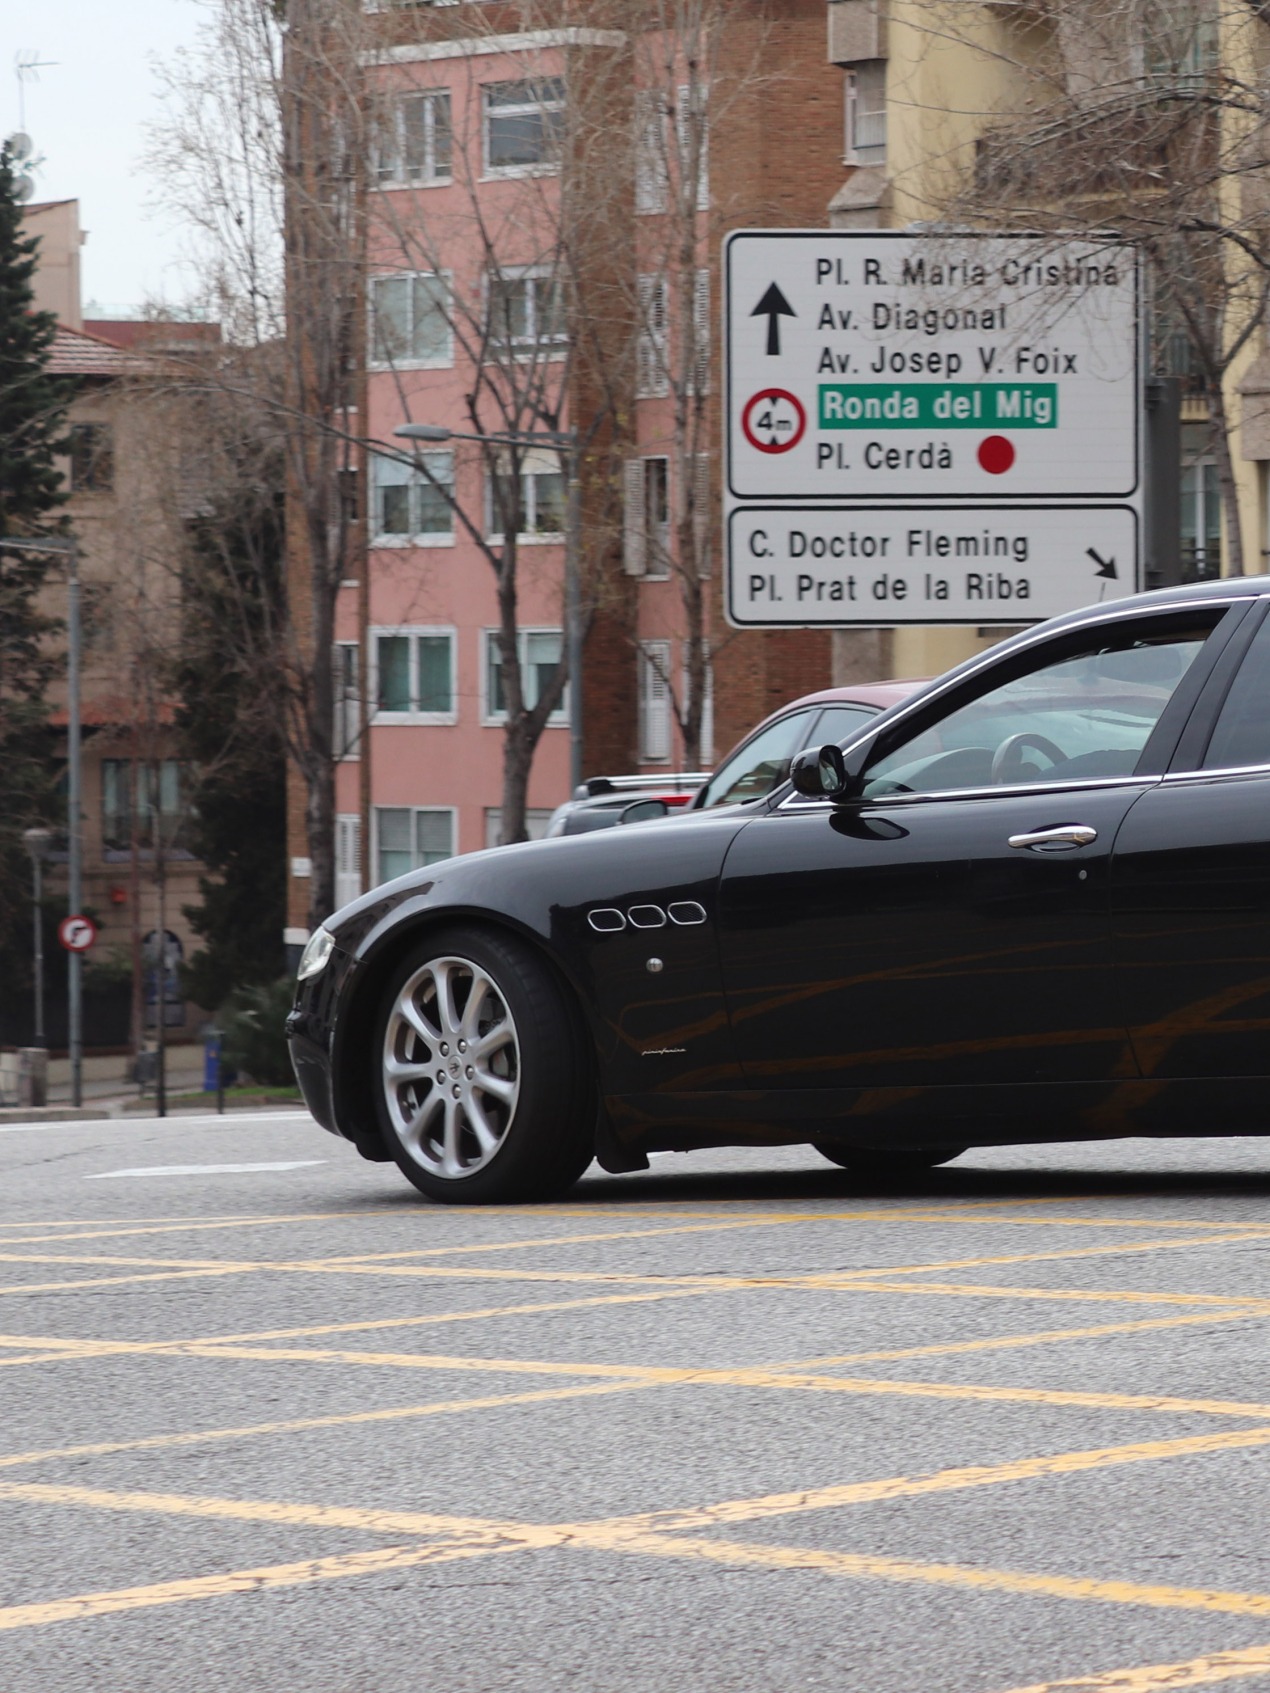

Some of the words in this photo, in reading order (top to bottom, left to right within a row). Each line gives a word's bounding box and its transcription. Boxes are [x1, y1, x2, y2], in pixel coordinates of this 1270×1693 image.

[817, 258, 849, 285] Pl.
[864, 258, 888, 286] R.
[902, 257, 985, 286] Maria
[1001, 257, 1118, 286] Cristina
[818, 303, 858, 331] Av.
[873, 302, 1006, 336] Diagonal
[818, 347, 859, 374] Av.
[871, 346, 962, 379] Josep
[978, 346, 1004, 374] V.
[1016, 347, 1077, 375] Foix
[824, 391, 919, 420] Ronda
[933, 391, 981, 420] del
[997, 390, 1052, 424] Mig
[817, 443, 850, 470] Pl.
[864, 442, 952, 470] Cerdà
[749, 530, 774, 558] C.
[788, 530, 890, 558] Doctor
[907, 529, 1029, 563] Fleming
[749, 574, 783, 602] Pl.
[798, 575, 857, 602] Prat
[873, 574, 908, 601] de
[926, 574, 950, 601] la
[966, 573, 1030, 600] Riba
